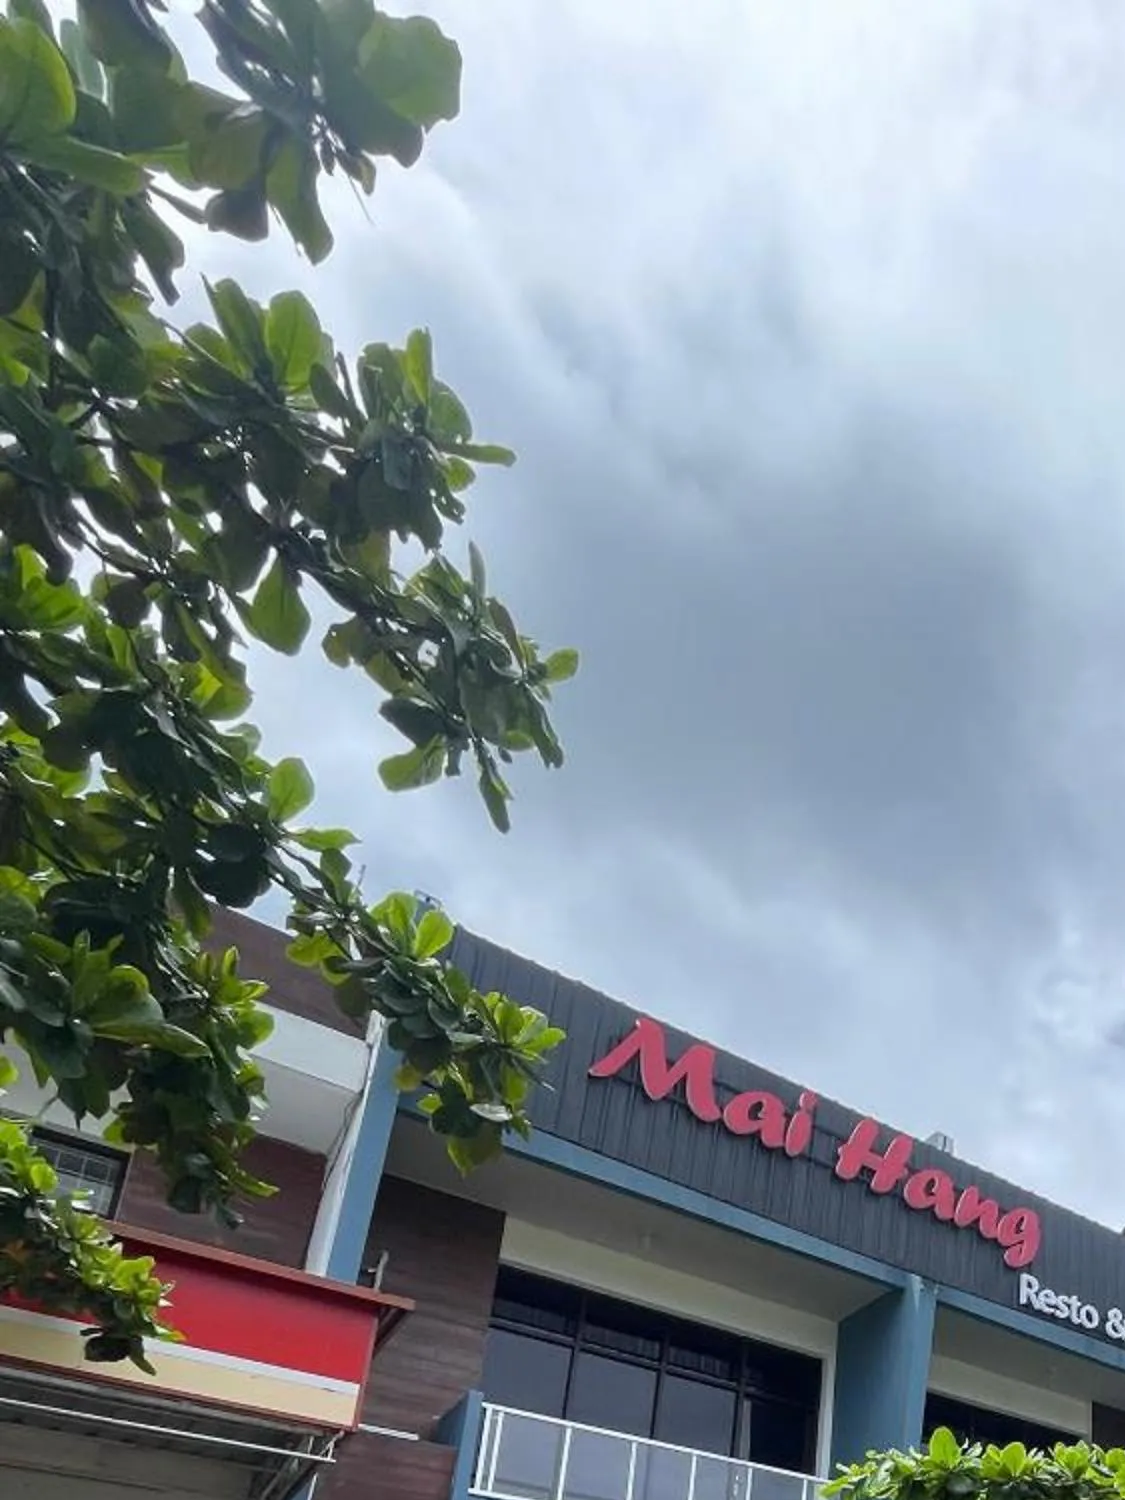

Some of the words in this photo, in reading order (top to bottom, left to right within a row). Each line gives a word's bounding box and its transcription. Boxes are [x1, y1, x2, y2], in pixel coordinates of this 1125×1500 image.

[588, 1016, 818, 1157] Mai
[834, 1116, 1042, 1269] Hang
[1018, 1272, 1099, 1330] Resto
